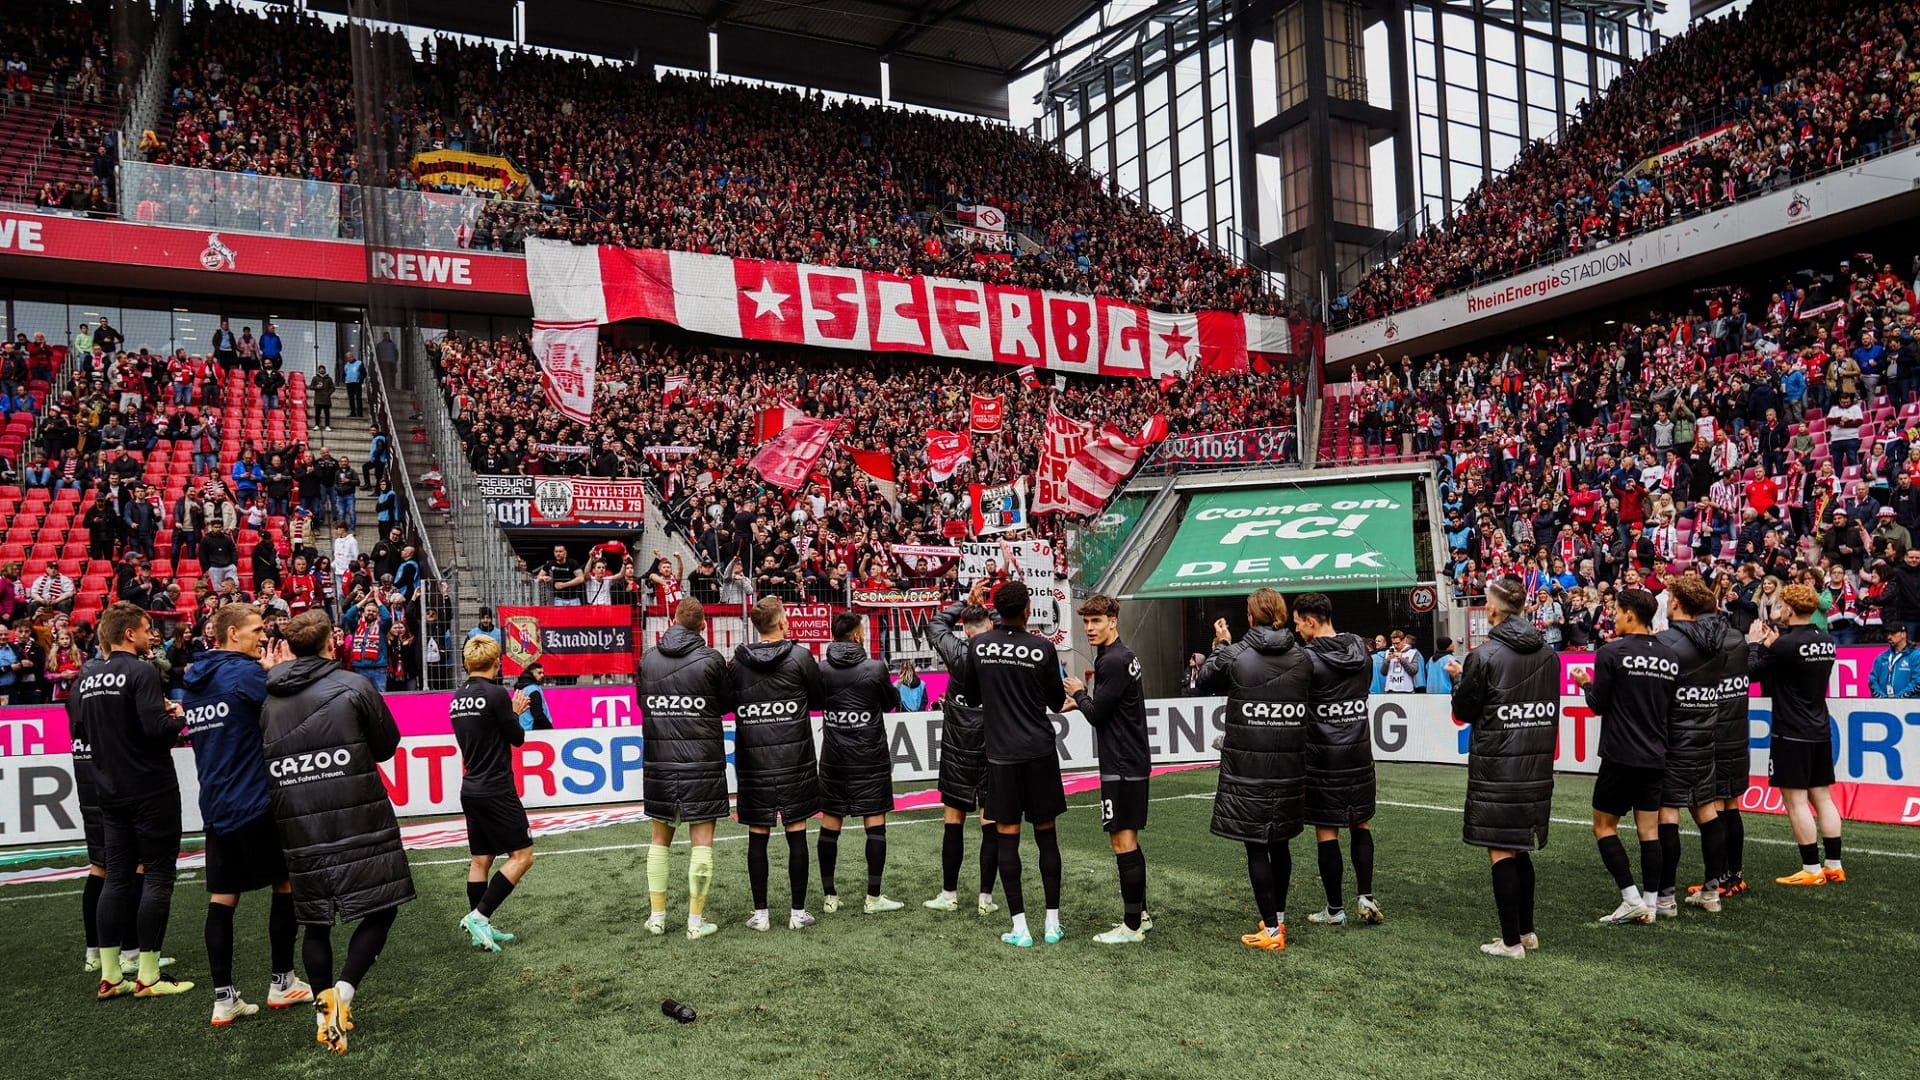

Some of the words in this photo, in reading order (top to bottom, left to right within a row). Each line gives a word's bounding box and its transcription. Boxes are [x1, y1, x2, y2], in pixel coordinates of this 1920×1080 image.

[372, 251, 473, 285] REWE
[476, 477, 532, 486] FREIBURG
[573, 483, 643, 498] SYNTHESIA
[578, 499, 623, 511] ULTRAS
[628, 500, 642, 511] 79
[1195, 503, 1322, 520] Come
[1220, 514, 1369, 545] FC!
[961, 543, 1022, 556] GÜNTR
[1175, 552, 1384, 577] DEVK
[792, 620, 829, 629] IMMER
[796, 629, 820, 637] UNS
[545, 628, 626, 650] Knaddly's
[976, 643, 1044, 661] CAZOO
[1622, 656, 1678, 675] CAZOO
[80, 673, 126, 693] CAZOO
[450, 697, 486, 710] AZOO
[646, 696, 706, 709] CAZOO
[737, 701, 798, 717] CAZOO
[1242, 703, 1306, 718] CAZOO
[1317, 699, 1369, 716] CAZO
[185, 702, 229, 725] AZOO
[1497, 703, 1555, 720] CAZOO
[269, 749, 351, 778] CAZOO
[298, 774, 320, 782] Fahren.
[321, 771, 345, 780] Freuen.
